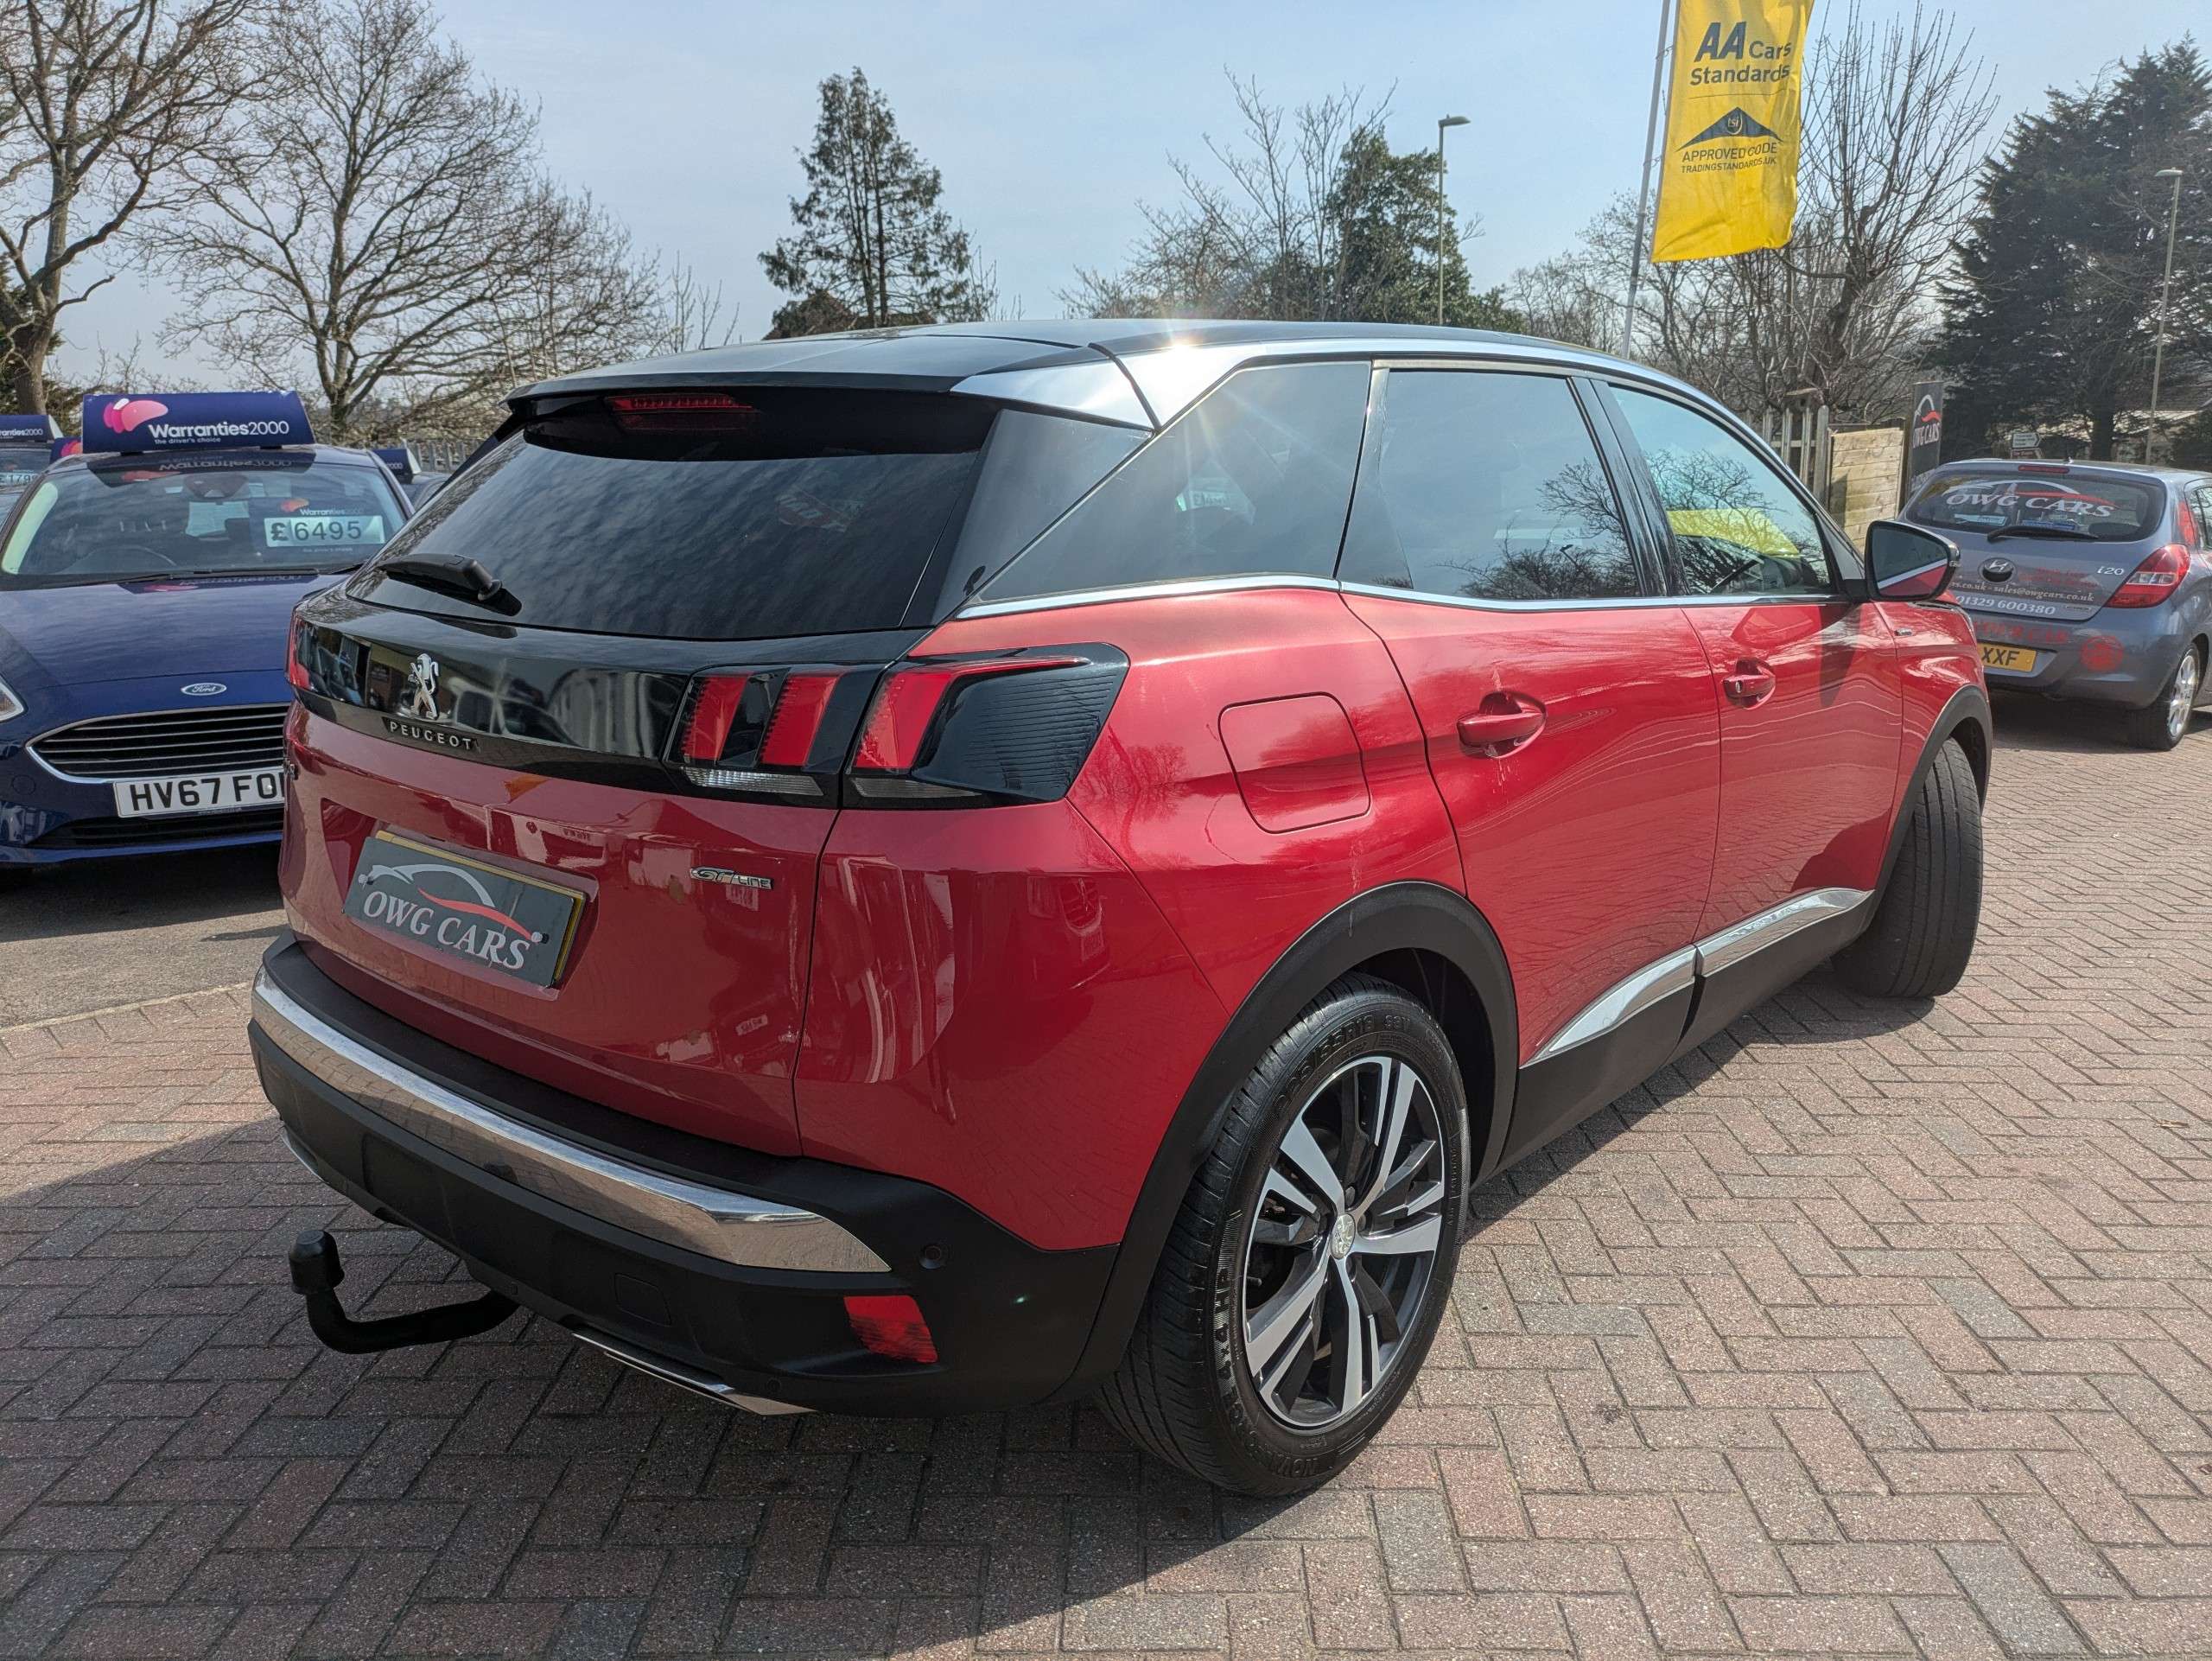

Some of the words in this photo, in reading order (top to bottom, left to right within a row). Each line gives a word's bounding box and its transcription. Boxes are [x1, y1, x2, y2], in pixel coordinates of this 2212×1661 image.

[1694, 21, 1747, 62] AA
[1749, 41, 1792, 60] Cars
[1690, 64, 1791, 86] Standards
[1681, 146, 1745, 162] APPROVED
[1747, 142, 1778, 156] CODE
[1681, 156, 1777, 173] TRADINGSTANDARDS.UK
[148, 421, 289, 438] Warranties2000
[1946, 493, 2020, 507] OWG
[2025, 497, 2114, 517] CARS
[1997, 599, 2056, 615] 600380
[1982, 646, 2020, 666] XXF
[389, 722, 474, 752] PEUGEOT
[130, 778, 221, 811] HV67
[232, 772, 284, 802] FO
[363, 890, 431, 936] OWG
[437, 916, 531, 971] CARS
